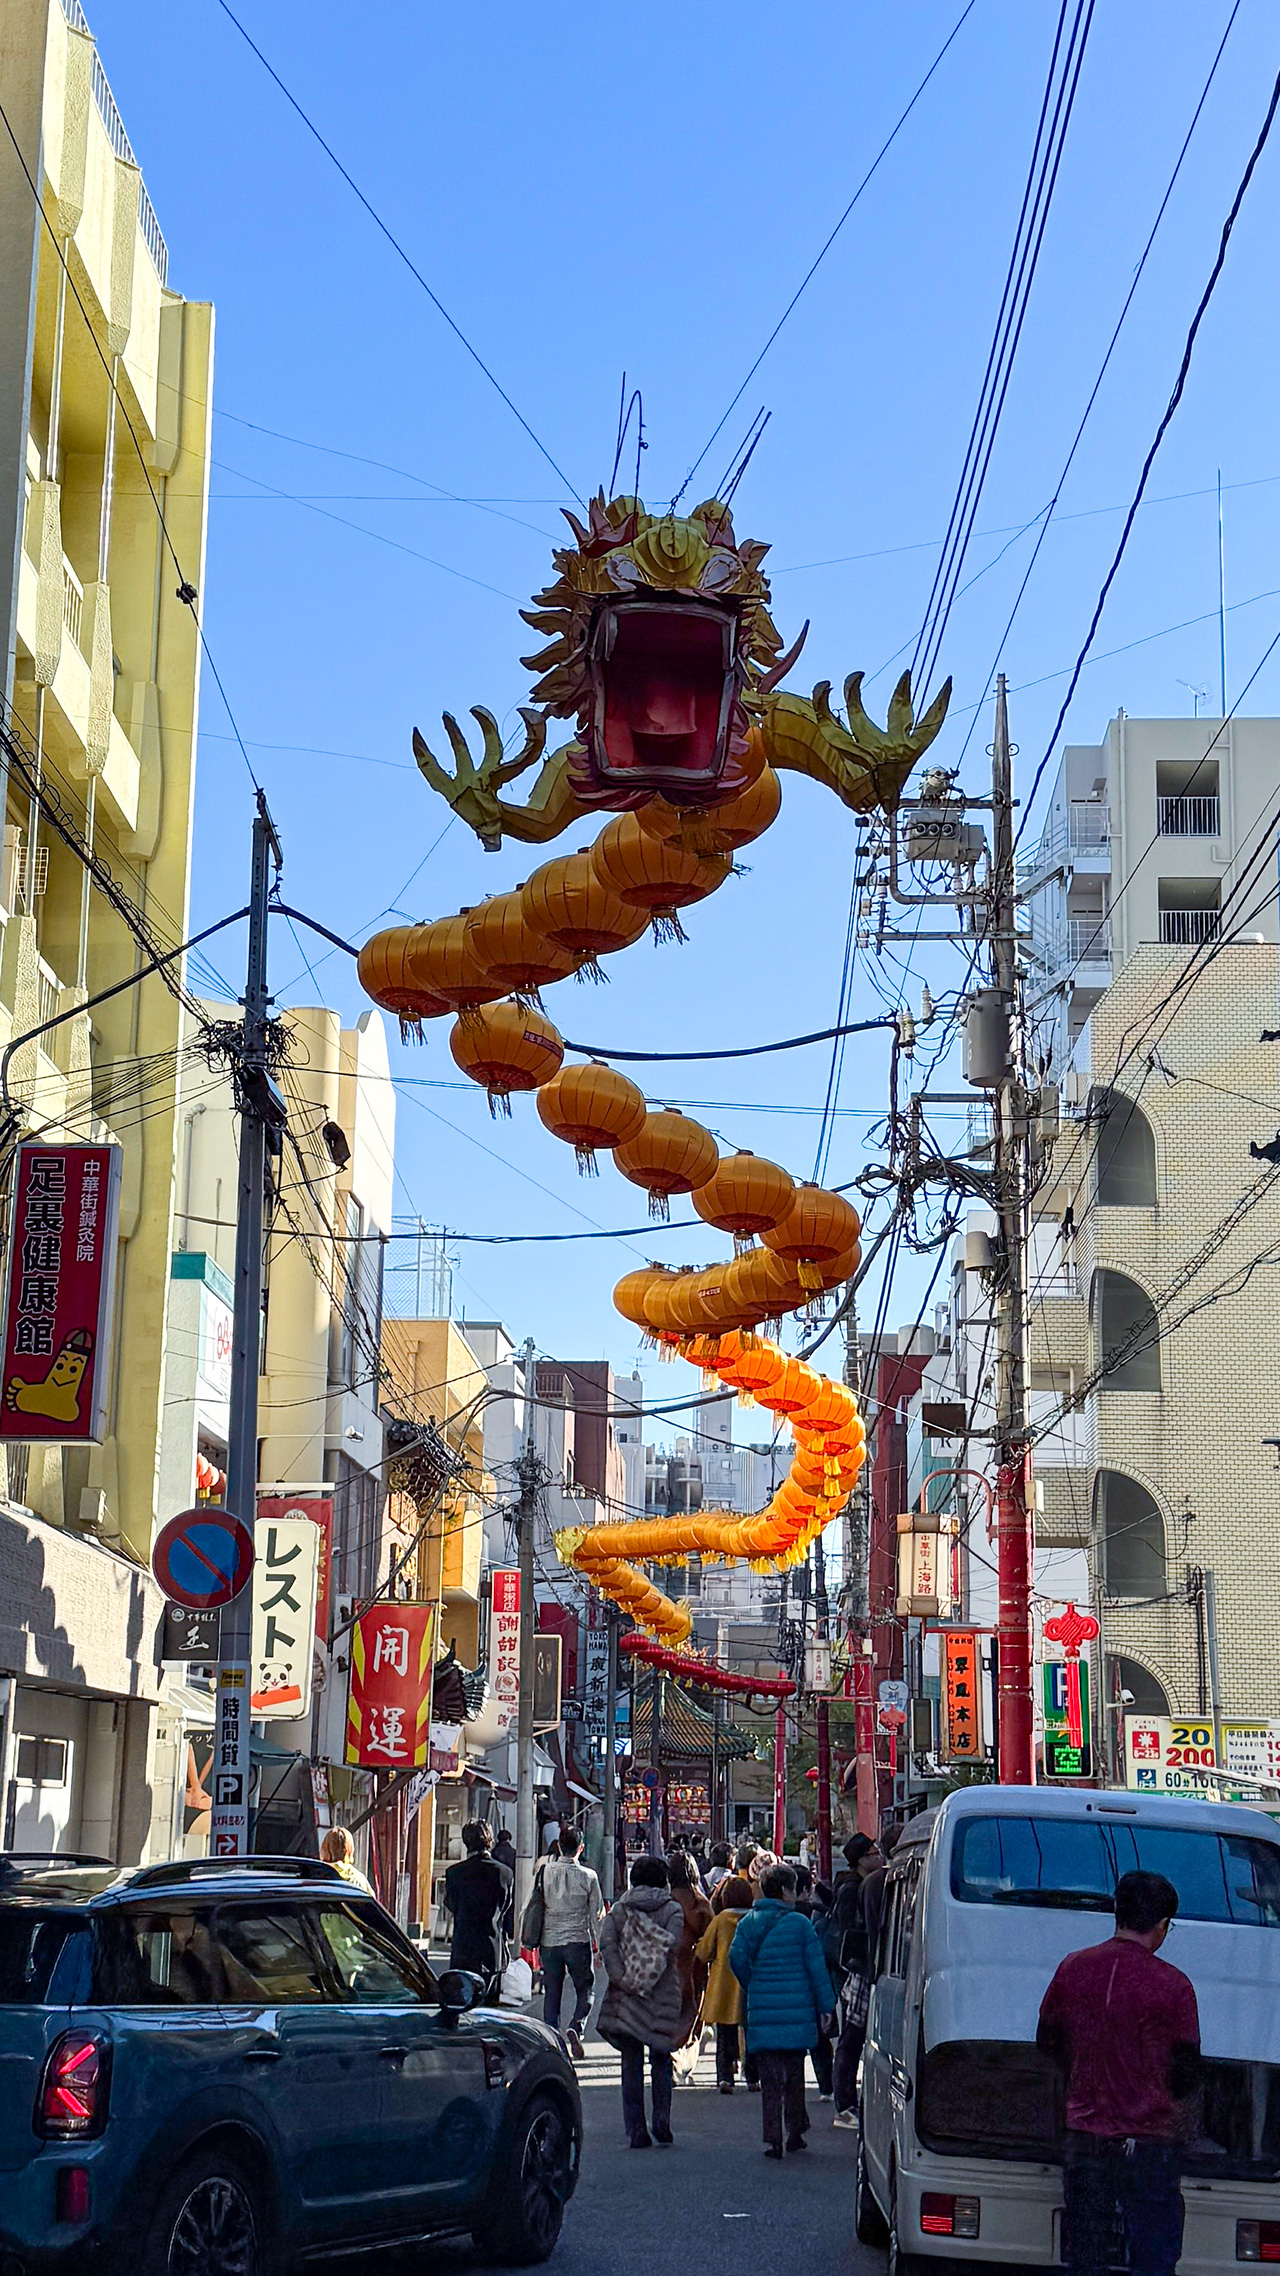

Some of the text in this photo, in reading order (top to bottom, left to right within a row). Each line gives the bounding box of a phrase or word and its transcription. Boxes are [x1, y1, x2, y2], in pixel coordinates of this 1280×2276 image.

[76, 1159, 101, 1262] 中華街鍼灸院
[14, 1156, 66, 1355] 足裏健康館
[260, 1528, 302, 1658] レスト
[502, 1573, 517, 1612] 中華粥店
[918, 1560, 932, 1595] 上海路
[496, 1615, 520, 1672] 謝甜記
[366, 1624, 410, 1758] 開運
[220, 1697, 240, 1766] 時間貸
[1172, 1728, 1210, 1746] 20
[1054, 1745, 1082, 1773] 空
[1166, 1748, 1215, 1767] 200
[217, 1776, 239, 1804] P
